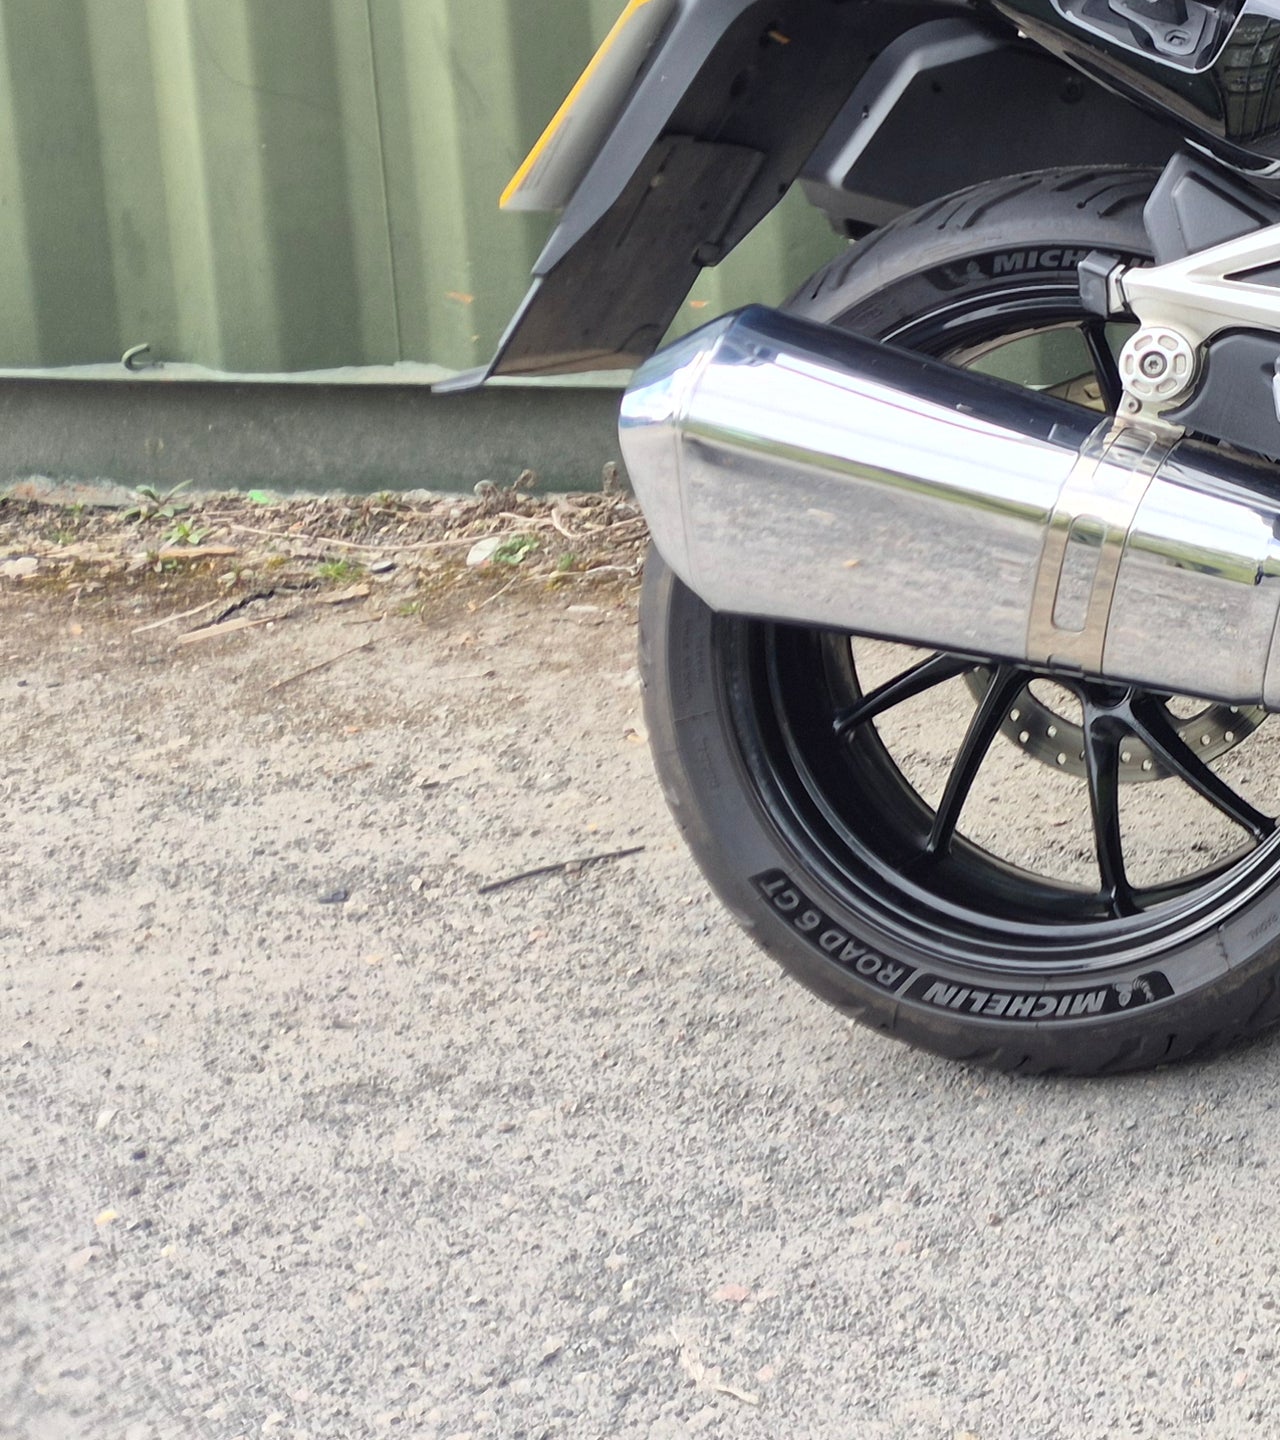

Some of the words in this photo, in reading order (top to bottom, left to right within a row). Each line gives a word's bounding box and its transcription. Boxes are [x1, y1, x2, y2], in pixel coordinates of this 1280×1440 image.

[759, 877, 800, 914] GT
[794, 912, 813, 932] 6
[818, 929, 904, 987] ROAD
[923, 981, 1107, 1019] MICHELIN
